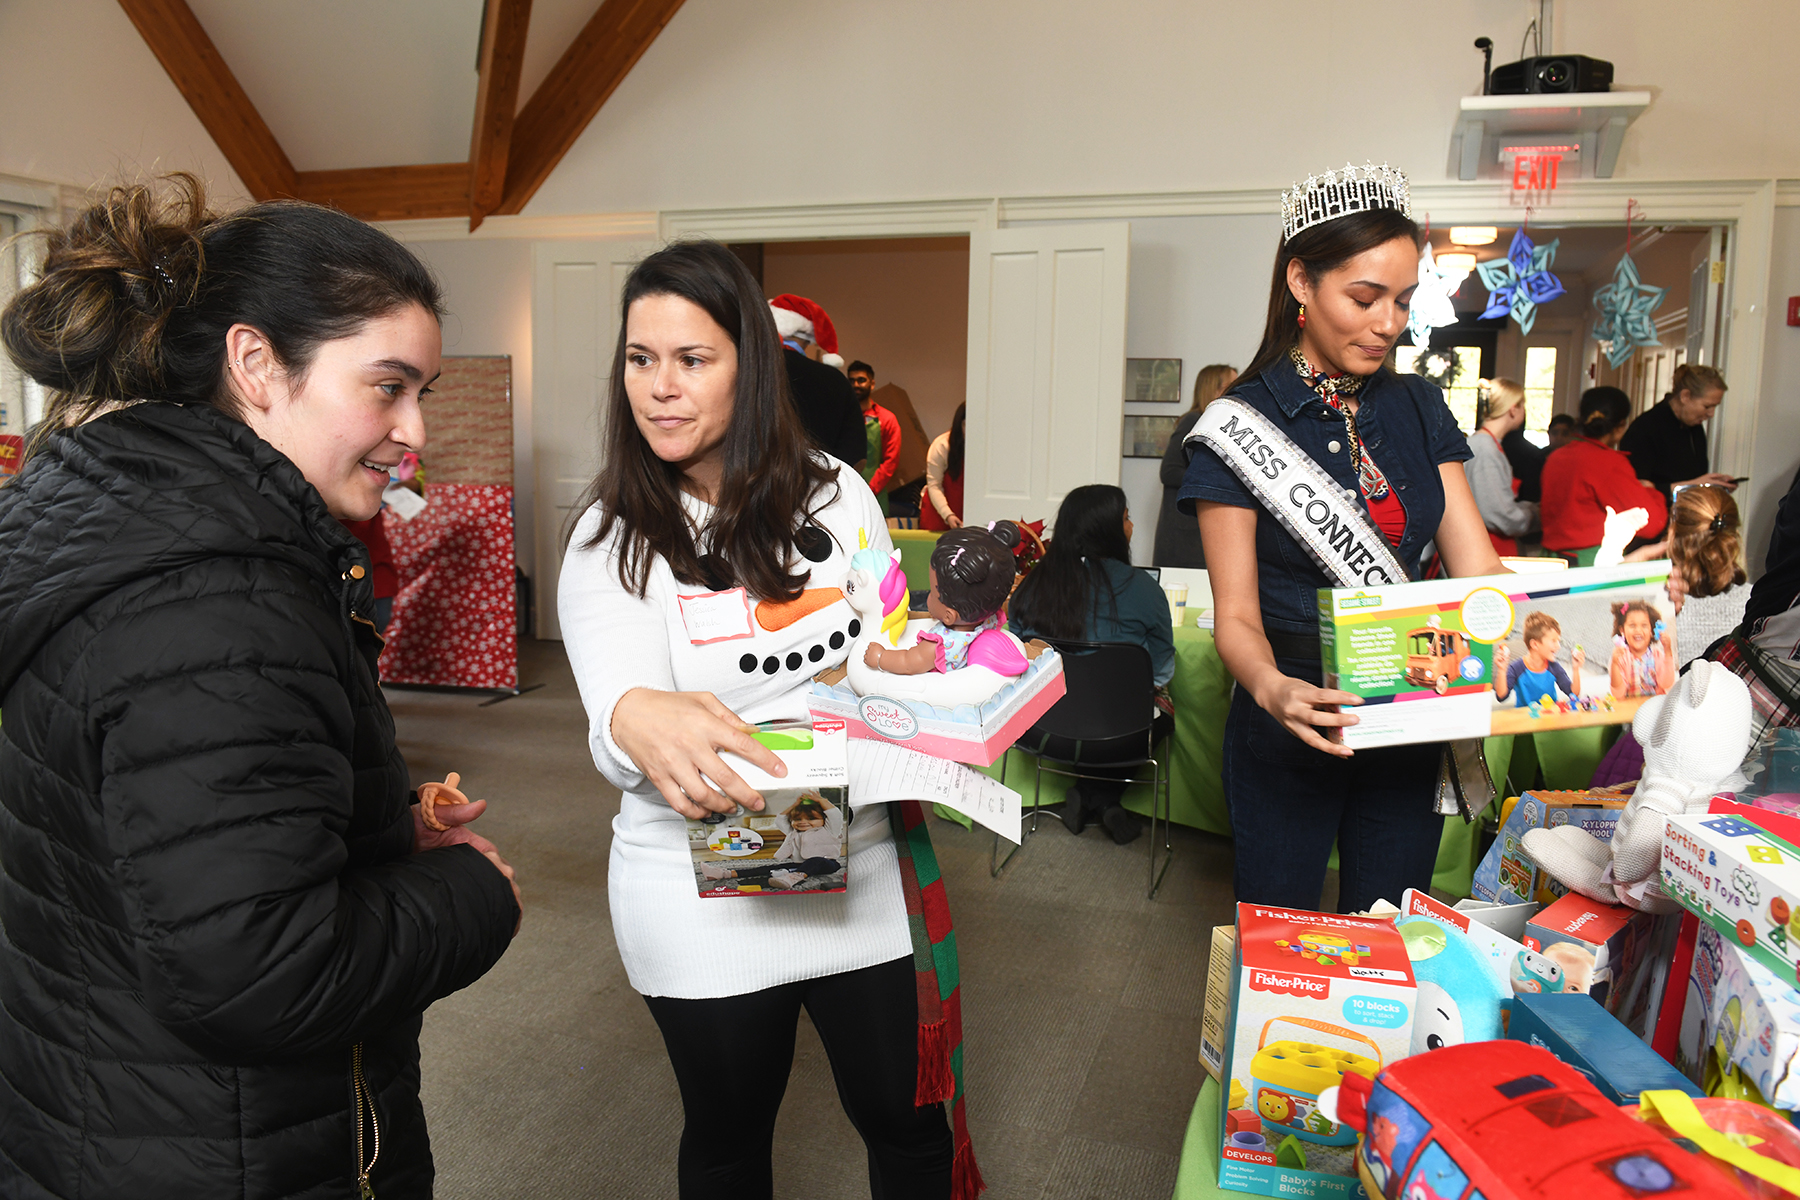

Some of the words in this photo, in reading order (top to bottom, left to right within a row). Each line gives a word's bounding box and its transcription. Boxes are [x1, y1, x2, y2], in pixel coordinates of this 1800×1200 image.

[1513, 154, 1563, 190] EXIT
[1219, 415, 1287, 480] MISS
[1289, 483, 1394, 587] CONNEC
[1665, 823, 1705, 862] Sorting
[1708, 850, 1717, 866] &
[1663, 845, 1711, 890] Stacking
[1714, 877, 1741, 906] Toys
[1255, 972, 1325, 992] Fisher-Price
[1352, 999, 1364, 1008] 10
[1366, 1001, 1400, 1013] blocks
[1226, 1149, 1273, 1163] DEVELOPS
[1279, 1184, 1315, 1196] Blocks
[1280, 1174, 1316, 1187] Baby's
[1320, 1180, 1345, 1191] First
